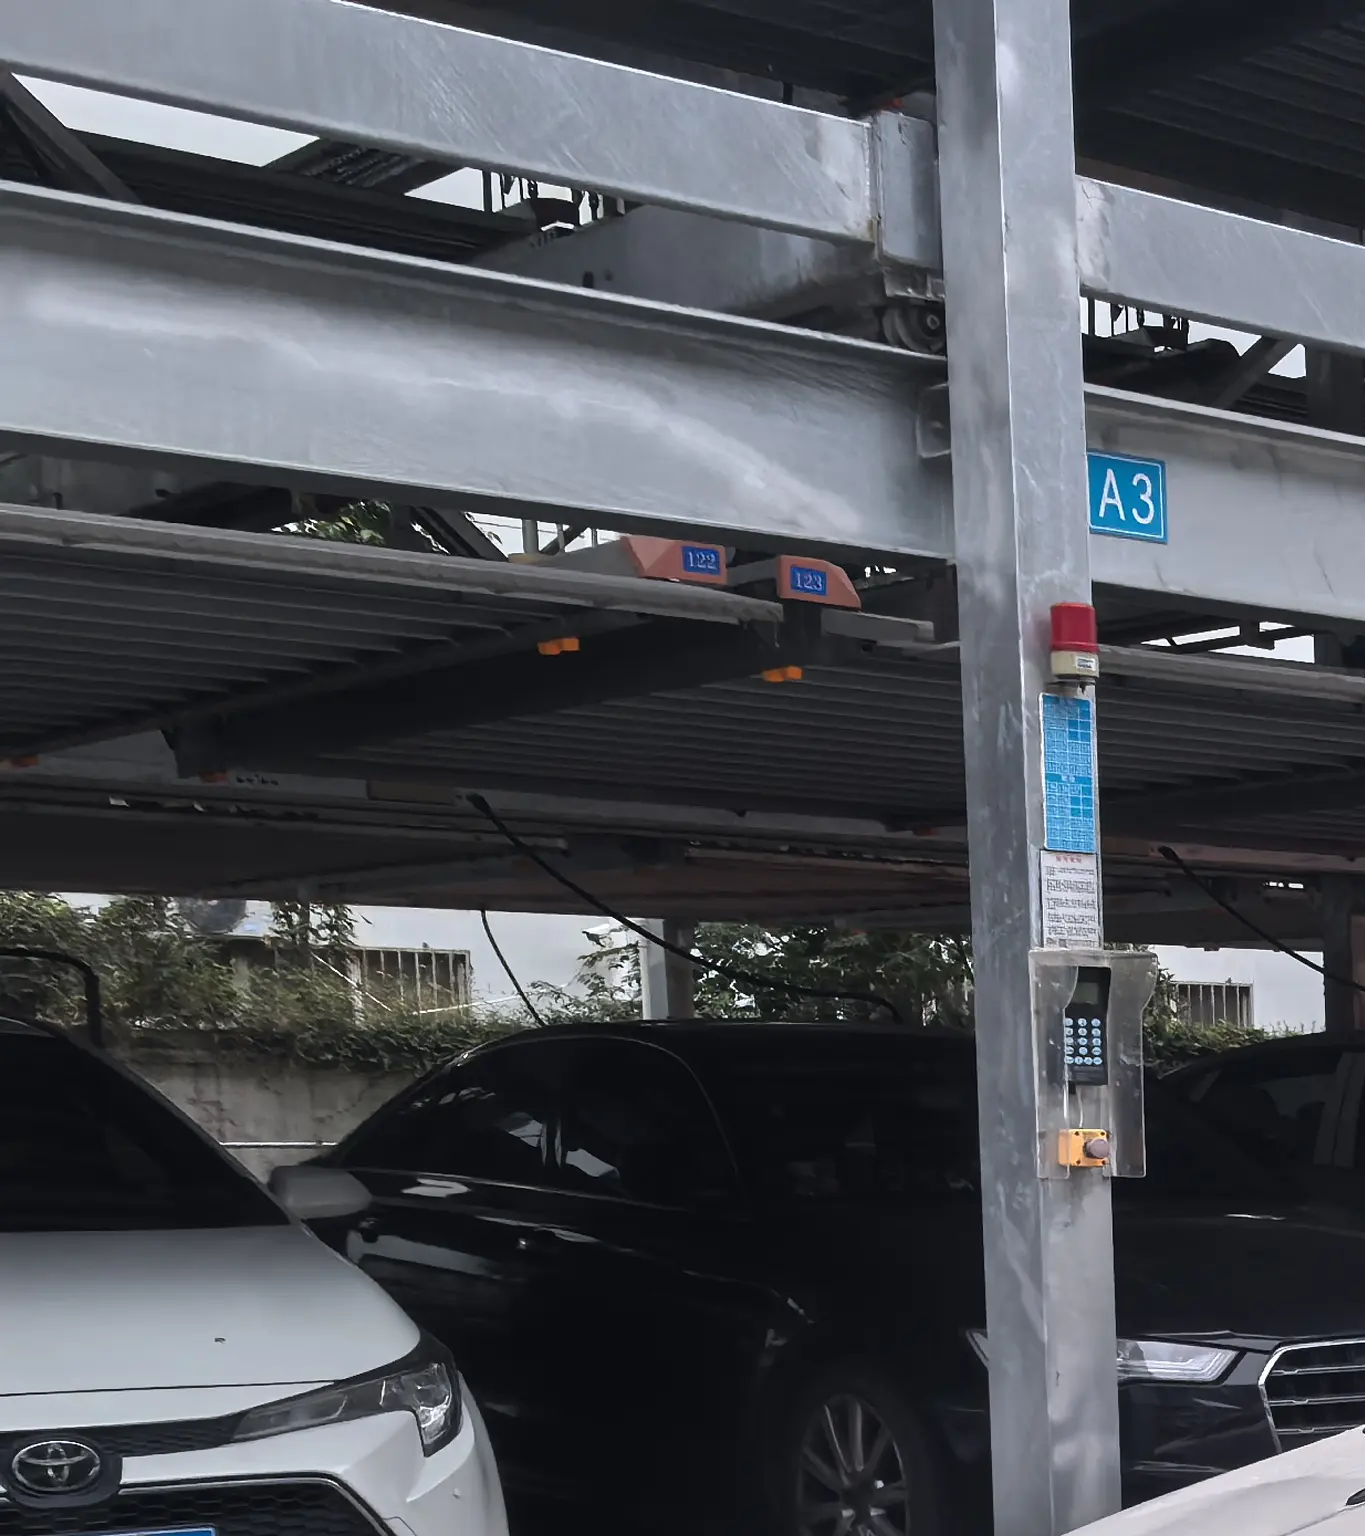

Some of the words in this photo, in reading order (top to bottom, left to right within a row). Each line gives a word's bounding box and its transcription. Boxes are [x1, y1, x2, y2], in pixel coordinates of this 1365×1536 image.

[1099, 468, 1155, 525] A3
[688, 551, 717, 571] 122
[795, 571, 823, 590] 123
